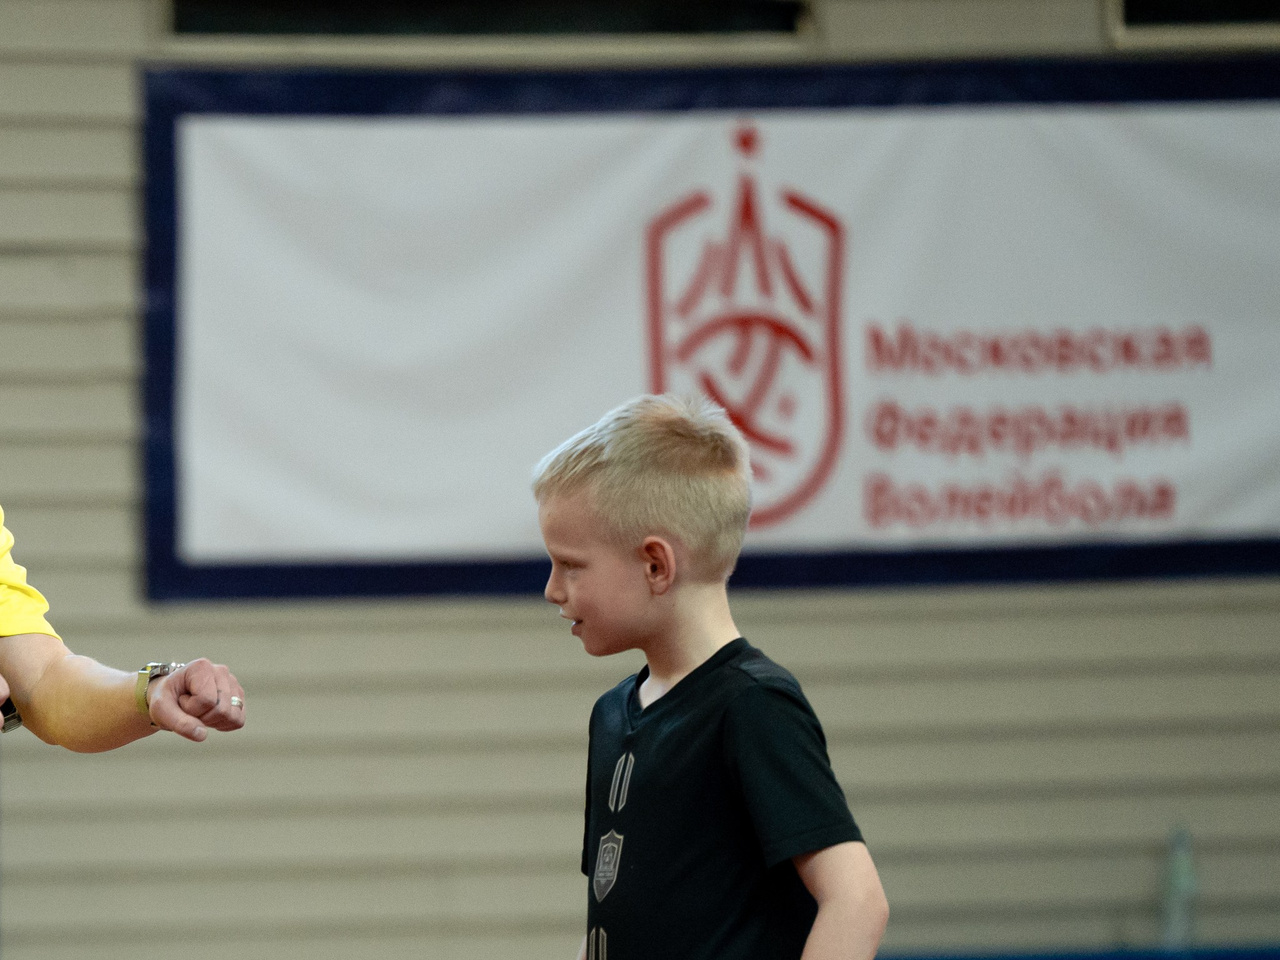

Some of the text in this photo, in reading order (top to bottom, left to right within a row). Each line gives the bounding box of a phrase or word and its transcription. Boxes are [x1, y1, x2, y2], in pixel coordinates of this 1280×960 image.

[867, 322, 1213, 376] Московская
[866, 397, 1190, 458] Федерация
[865, 473, 1177, 528] Волейбола
